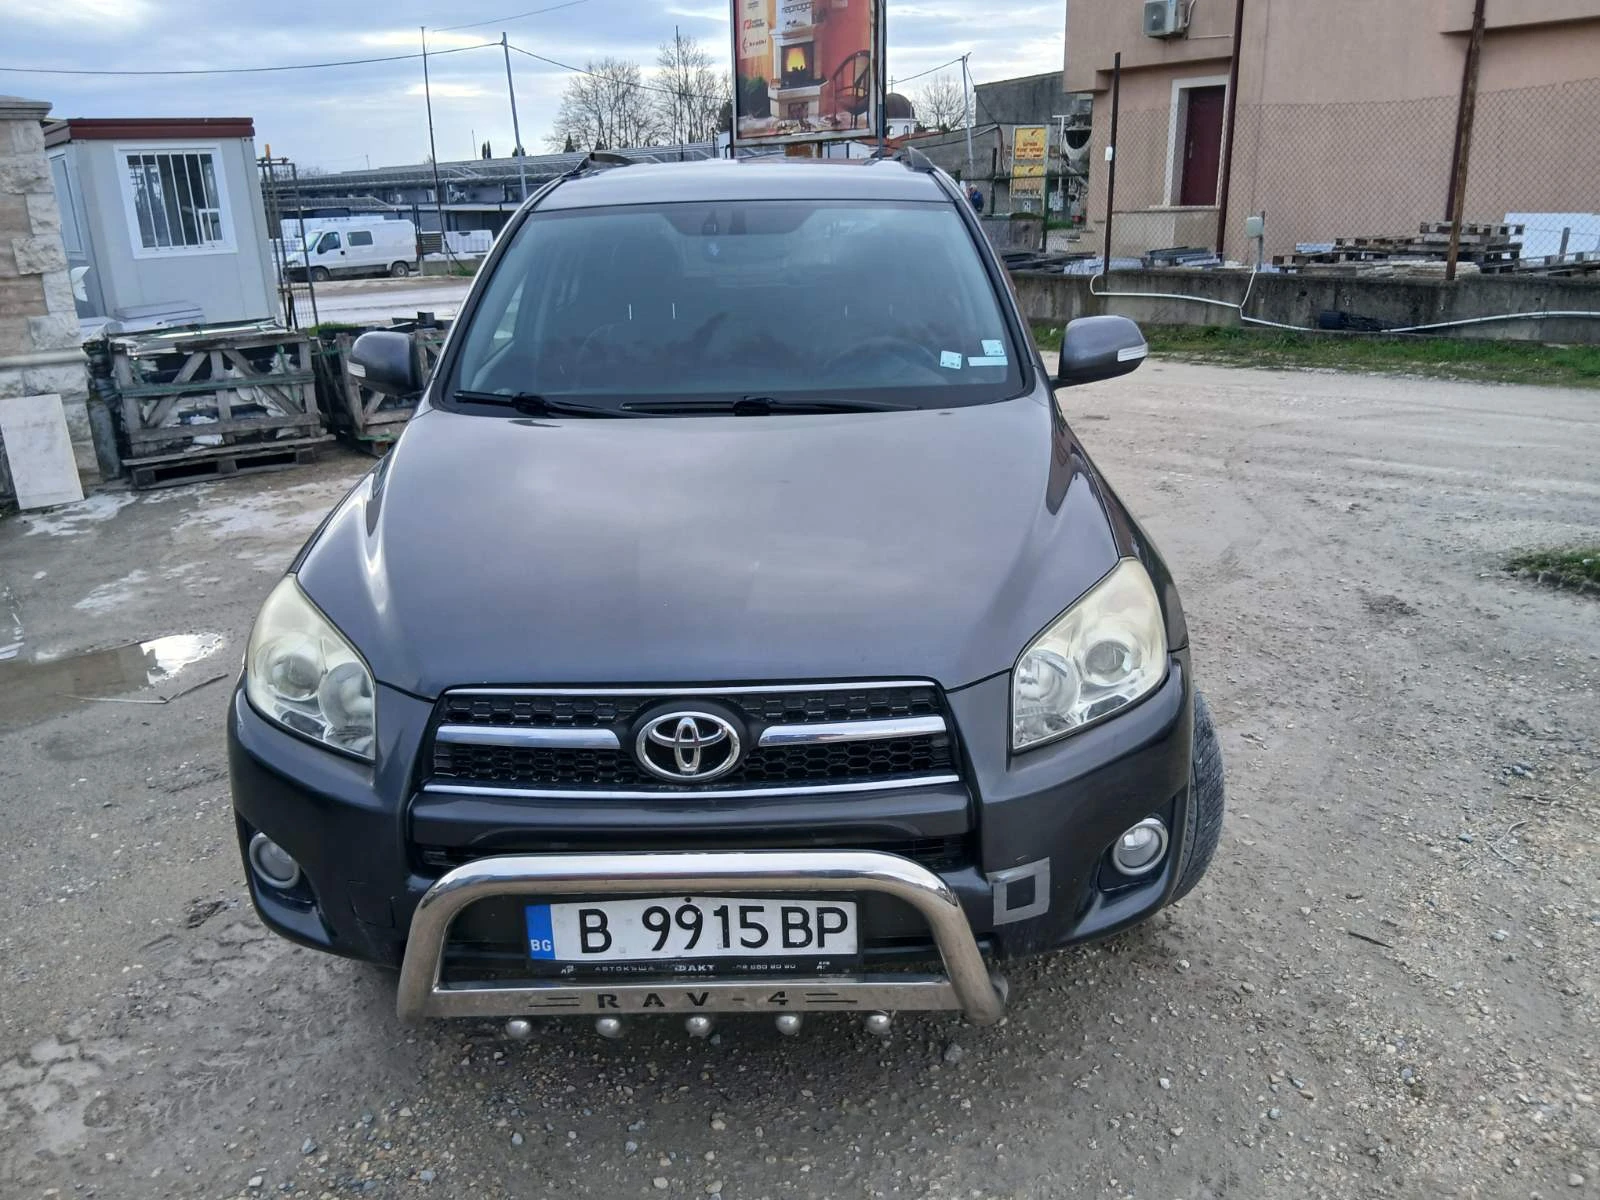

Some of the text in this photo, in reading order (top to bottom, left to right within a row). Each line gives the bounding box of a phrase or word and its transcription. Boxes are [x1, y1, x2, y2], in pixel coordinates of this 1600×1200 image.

[530, 938, 552, 952] BG
[578, 904, 848, 954] B 9915 BP
